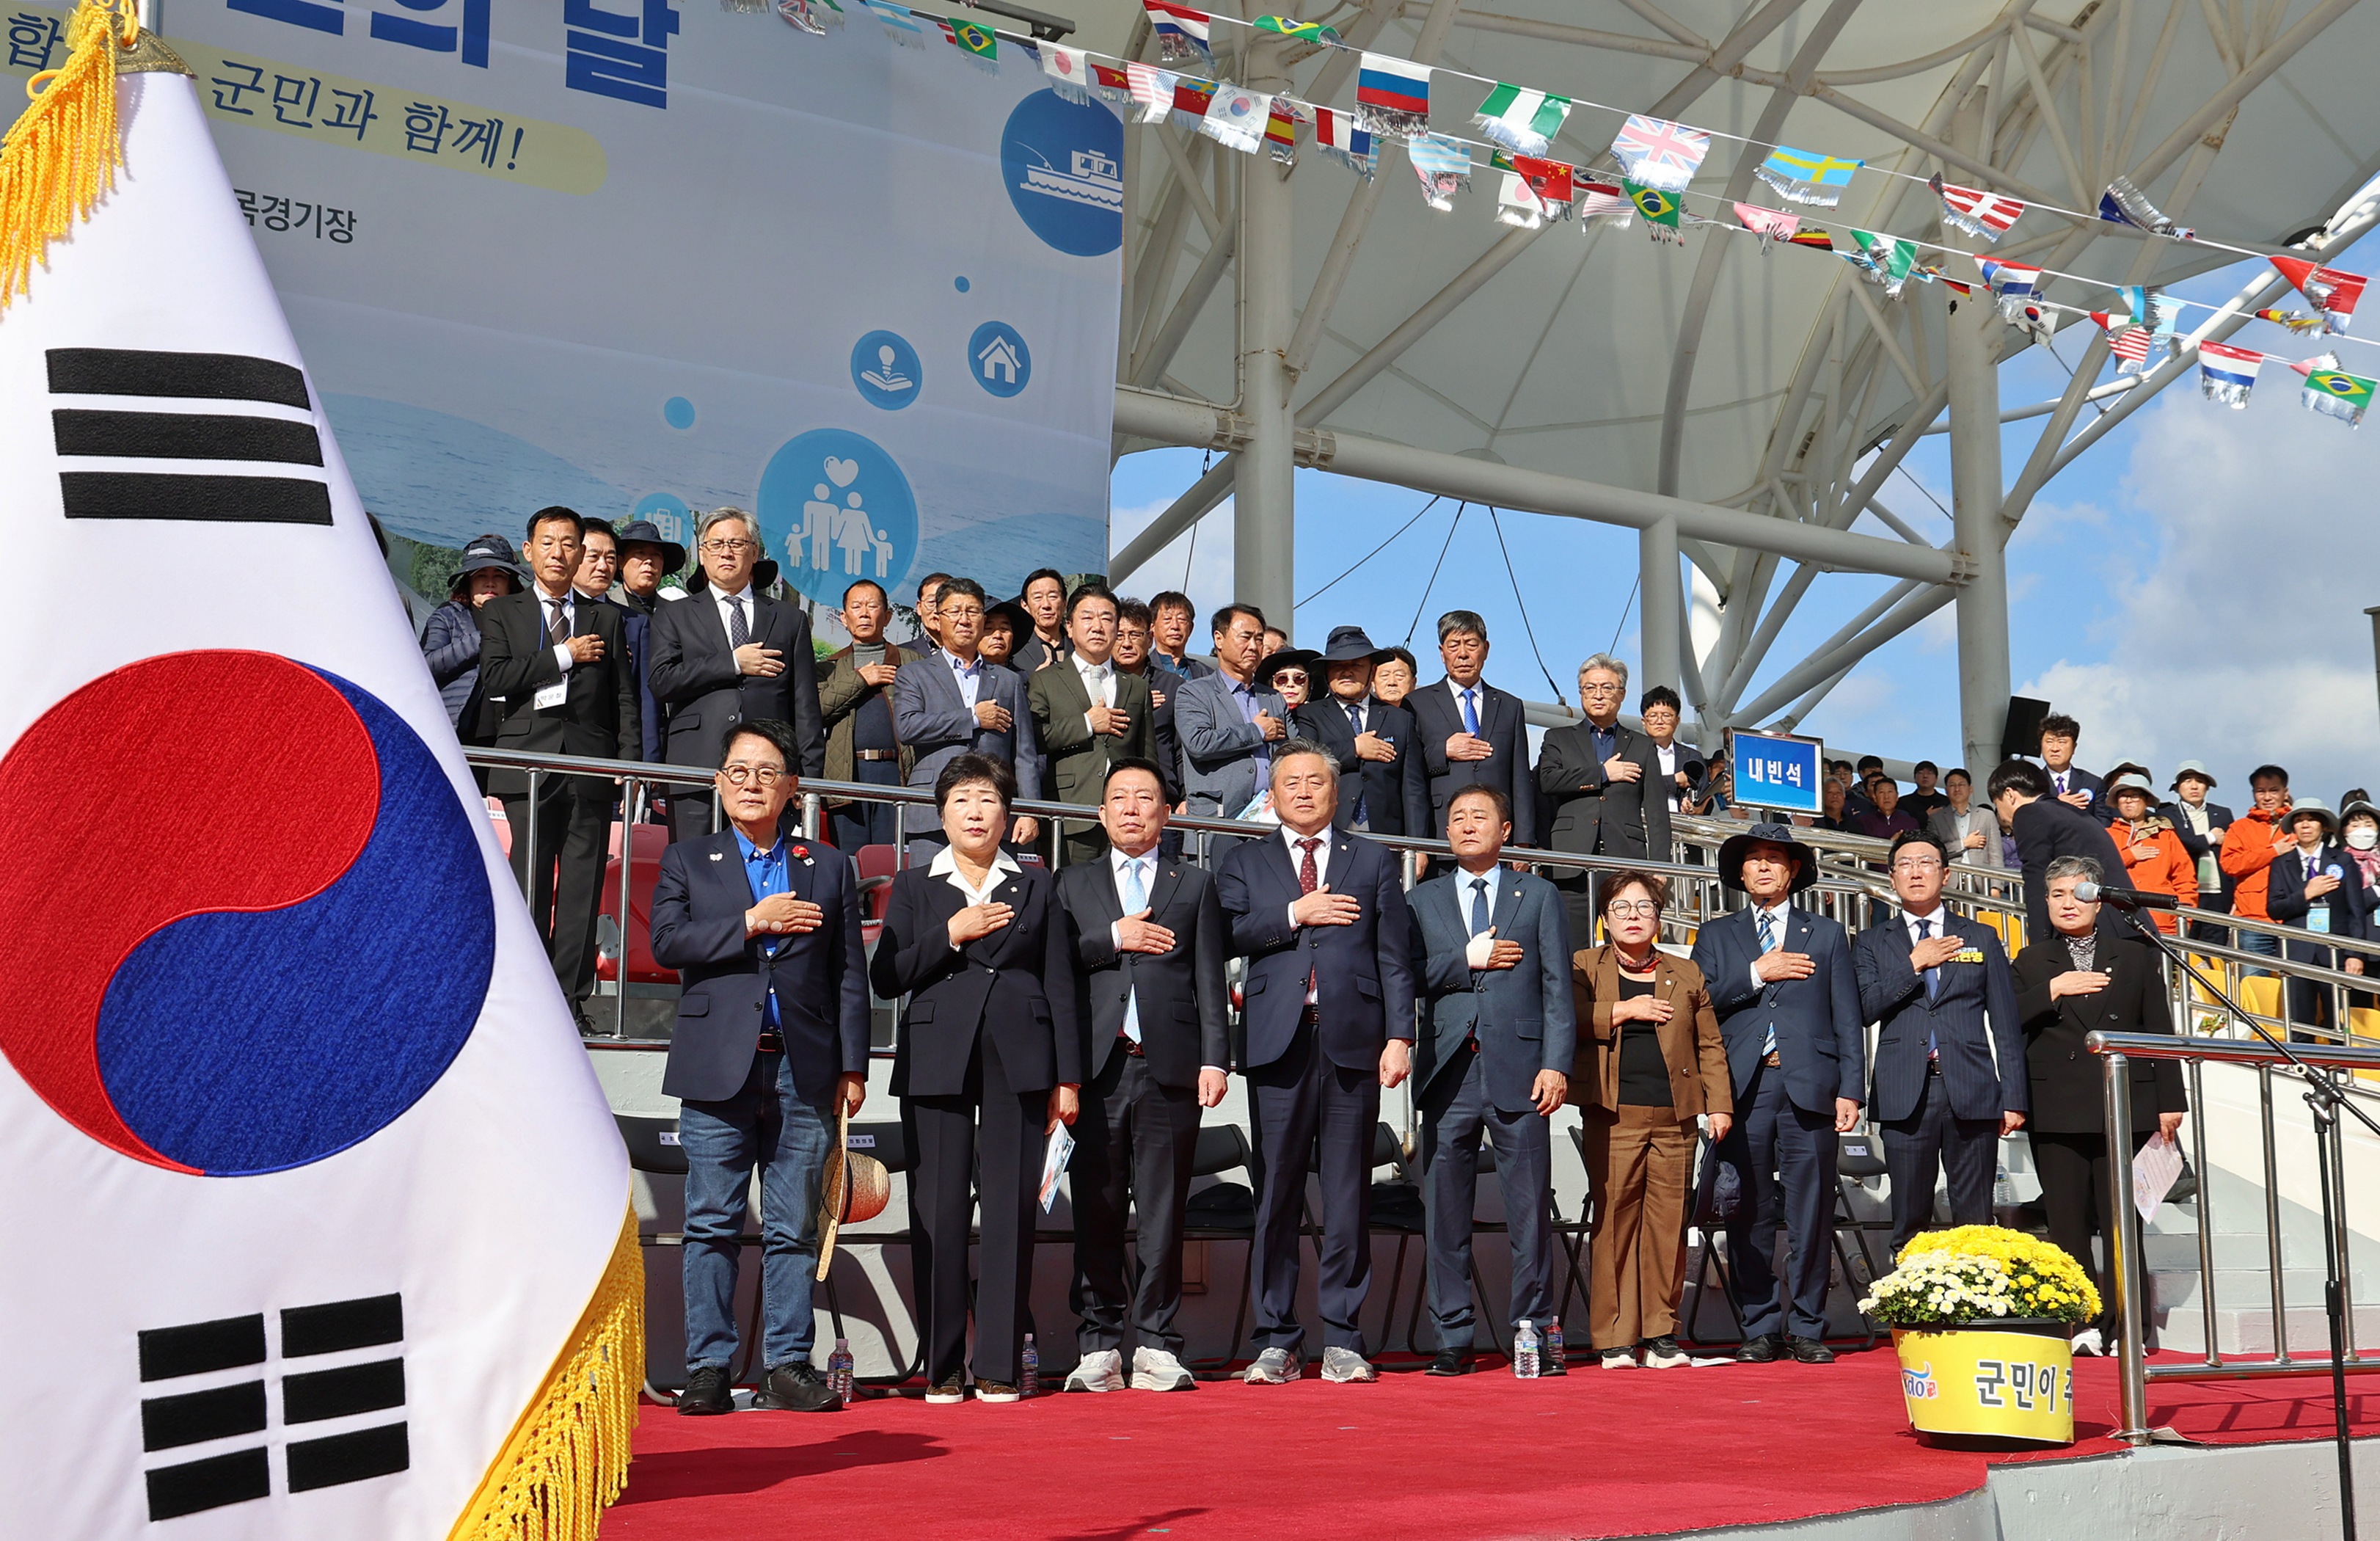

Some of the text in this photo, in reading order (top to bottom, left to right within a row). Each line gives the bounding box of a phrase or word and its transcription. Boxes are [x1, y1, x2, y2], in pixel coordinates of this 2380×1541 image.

[211, 59, 379, 142] 군민과
[404, 101, 525, 171] 함께!
[1748, 757, 1802, 788] 내빈석
[1976, 1361, 2056, 1412] 군민이
